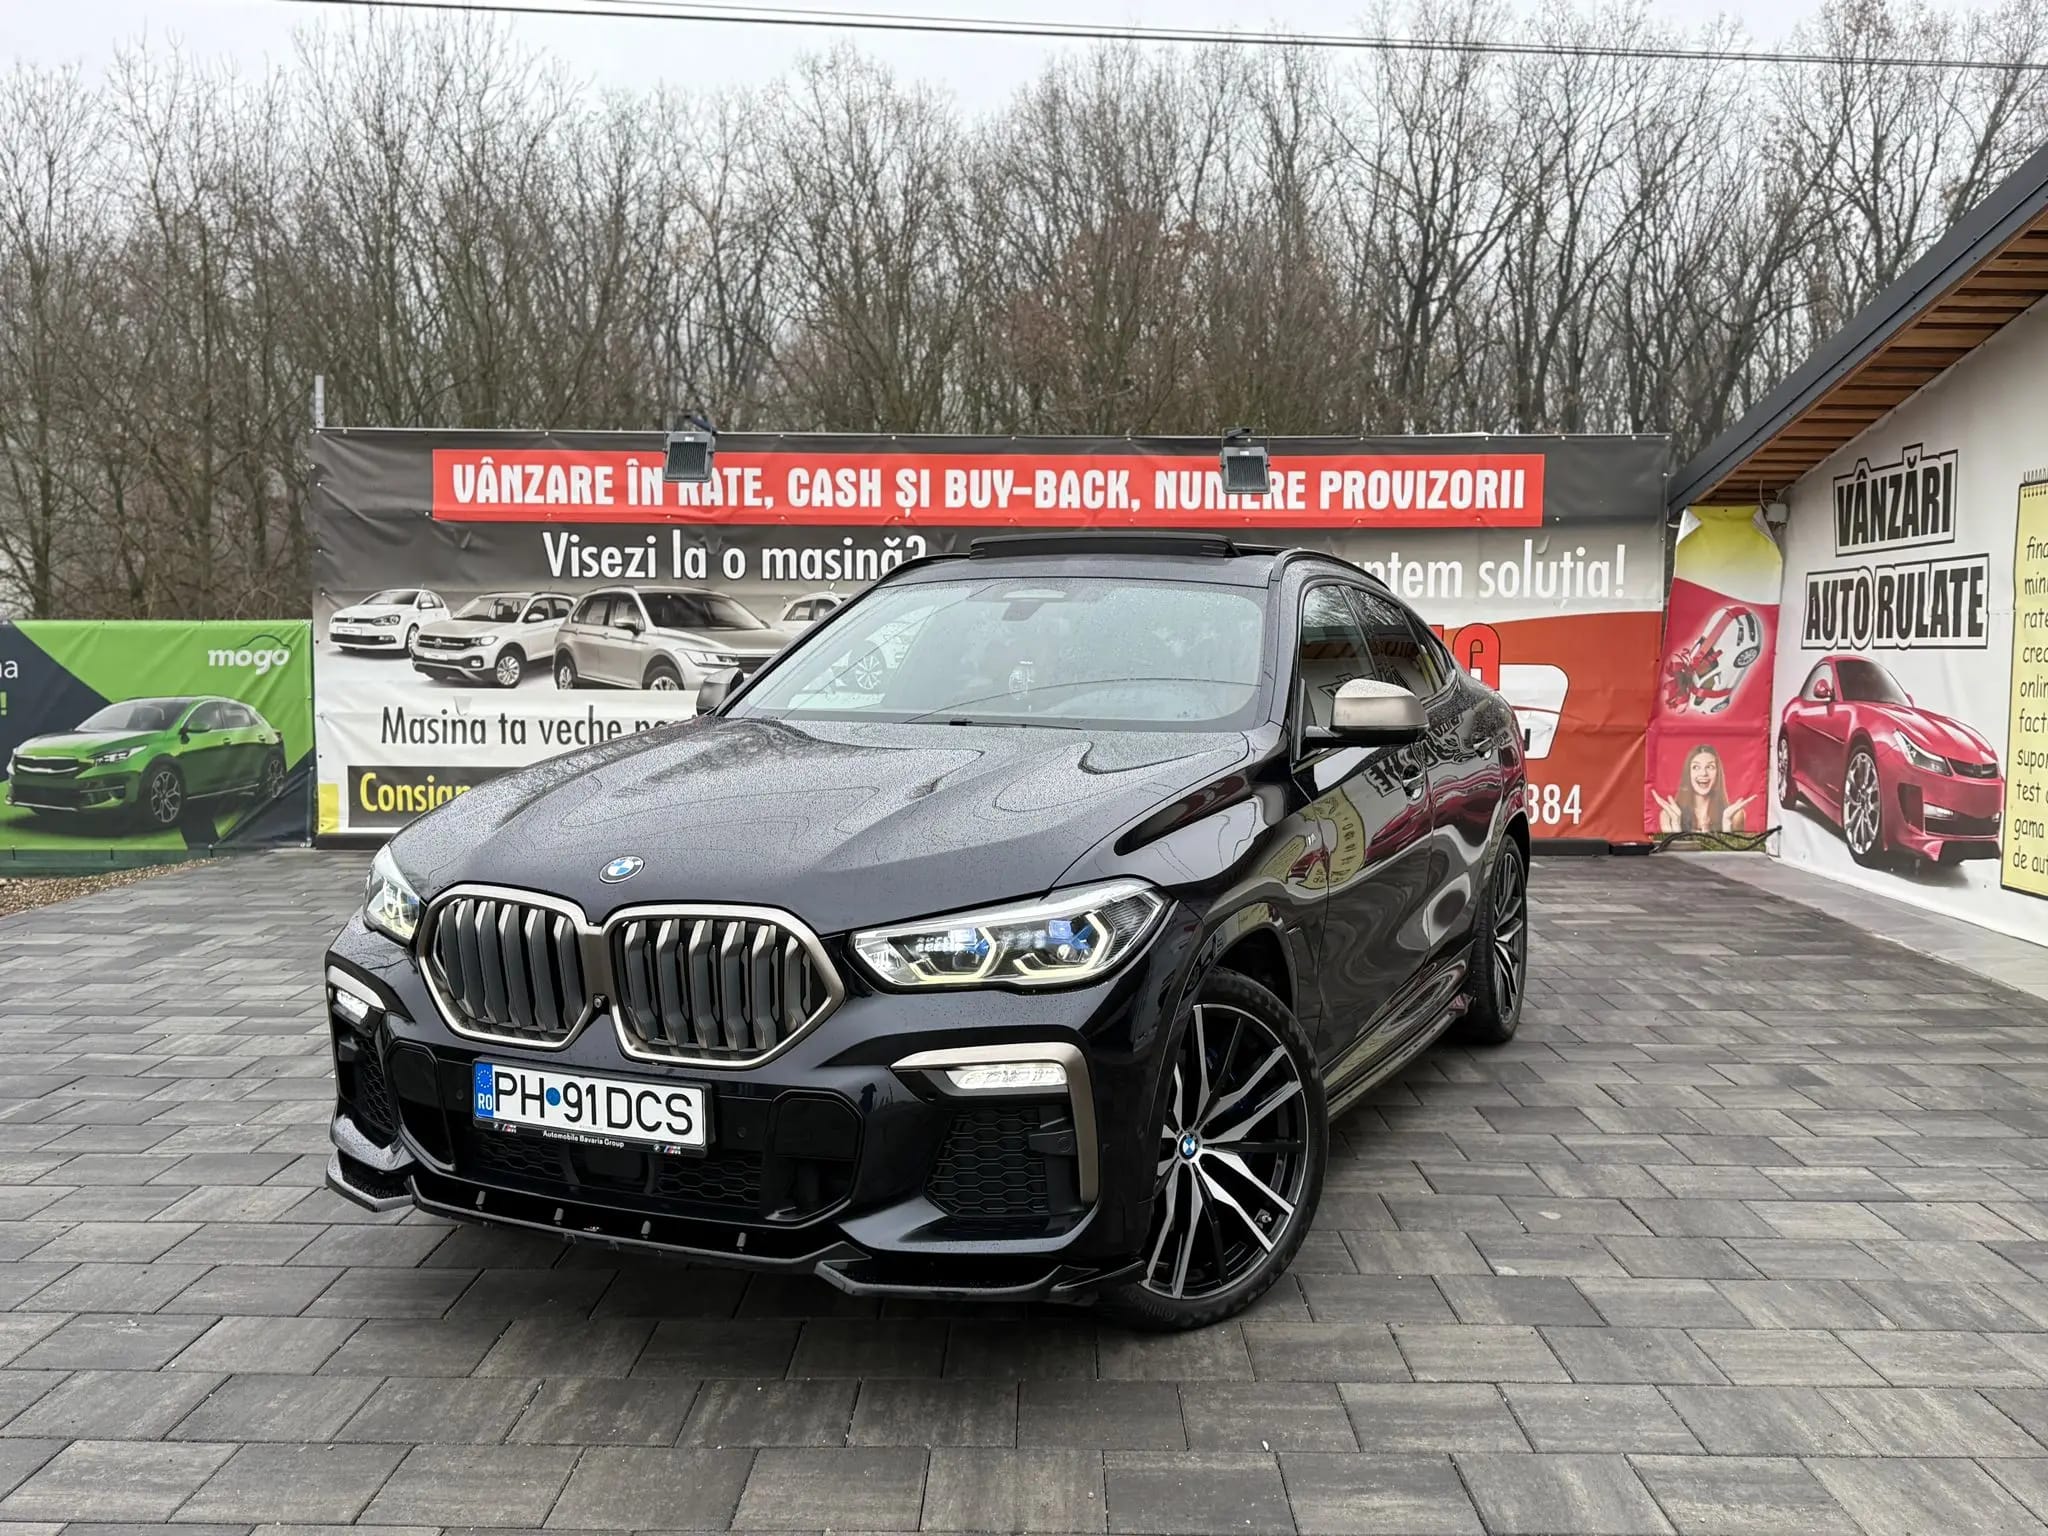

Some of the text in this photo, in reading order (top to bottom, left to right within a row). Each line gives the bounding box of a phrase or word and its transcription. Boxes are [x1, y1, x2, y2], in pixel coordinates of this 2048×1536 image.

[453, 456, 614, 505] VÂNZARE
[626, 458, 664, 506] ÎN
[787, 467, 882, 508] CASH
[895, 468, 931, 518] ȘI
[1319, 469, 1525, 510] PROVIZORII
[1837, 456, 1953, 547] VÂNZĂRI
[542, 532, 657, 579] Visezi
[672, 529, 707, 580] la
[722, 547, 747, 580] o
[1352, 552, 1463, 598] ntem
[1805, 566, 1984, 641] AUTO RULATE
[207, 649, 290, 675] mogo
[498, 712, 527, 745] ta
[539, 705, 622, 745] veche
[2019, 708, 2048, 733] fact
[2016, 780, 2041, 803] test
[2013, 818, 2044, 840] gama
[2013, 845, 2028, 870] de
[478, 1093, 493, 1111] RO
